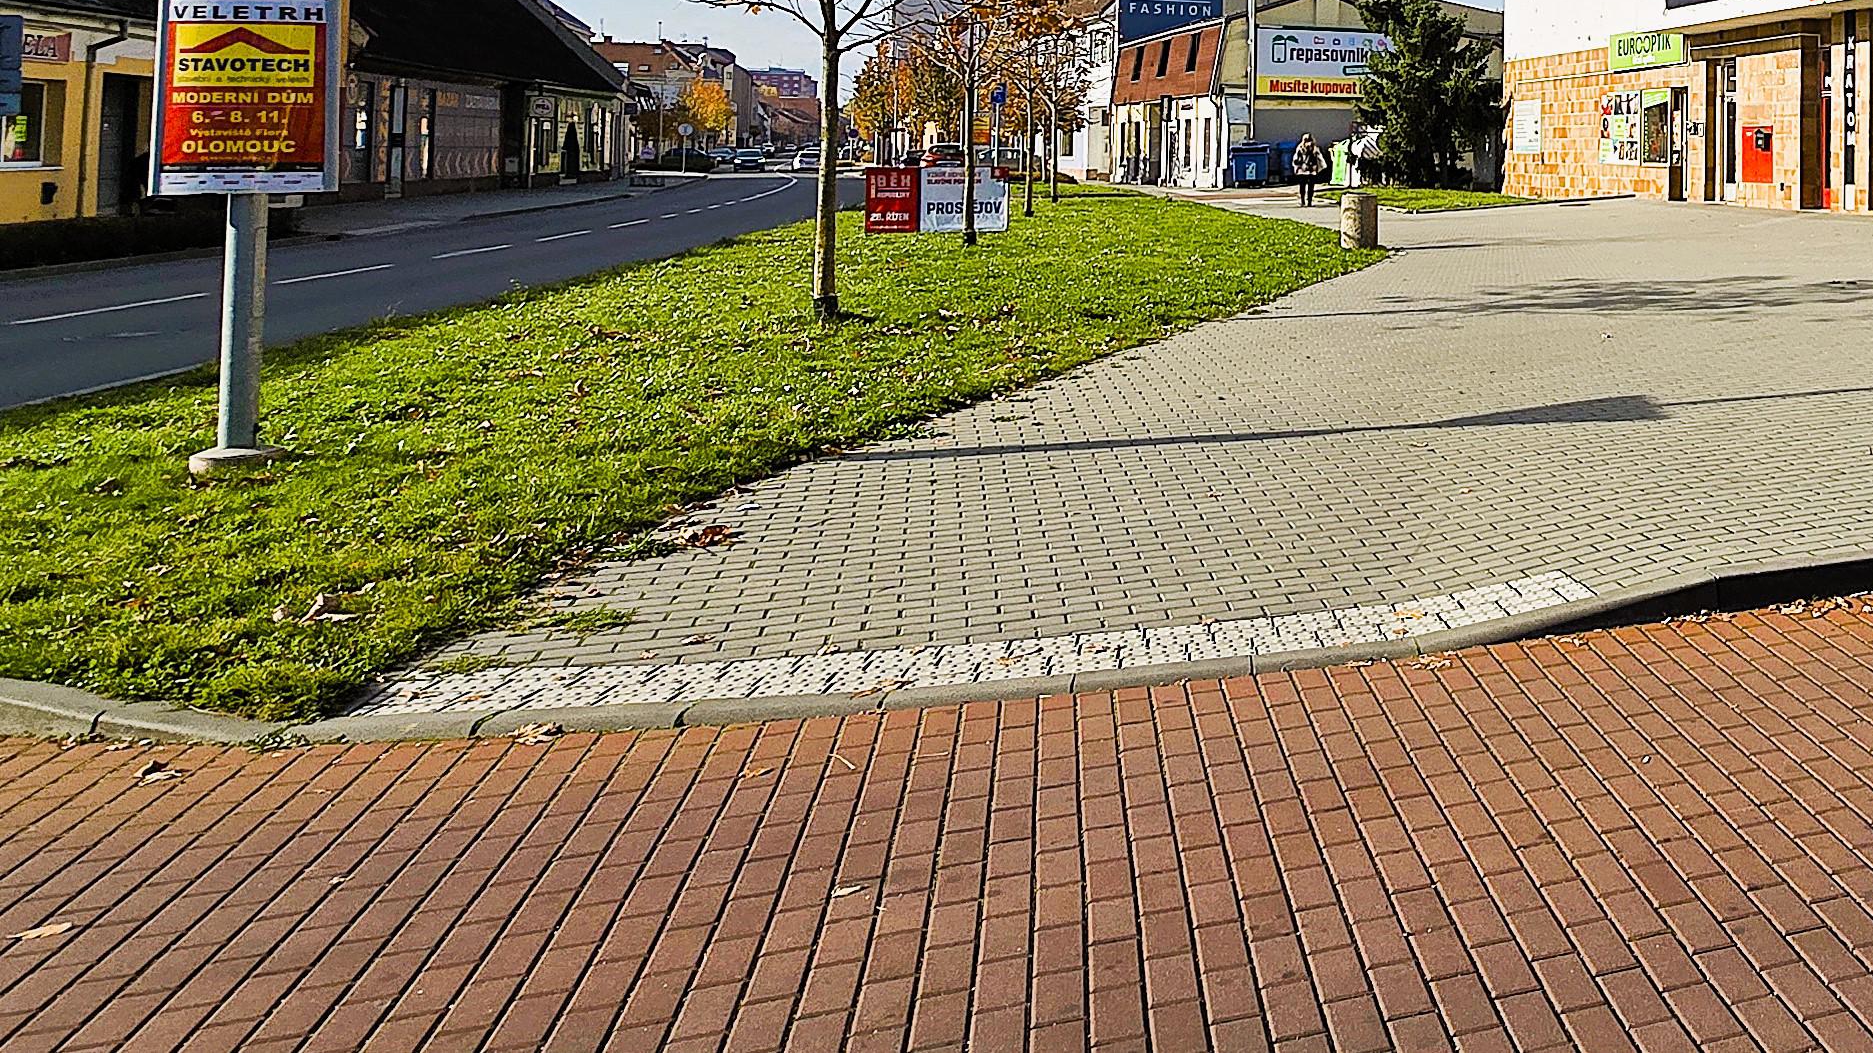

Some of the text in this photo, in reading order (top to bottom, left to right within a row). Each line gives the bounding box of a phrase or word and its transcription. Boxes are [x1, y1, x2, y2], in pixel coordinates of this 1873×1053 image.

[173, 5, 325, 22] VELETRH
[1129, 2, 1212, 17] FASHION
[1617, 33, 1672, 57] EUROOPTIK
[178, 57, 310, 72] STAVOTECH
[1310, 80, 1358, 95] kupovat
[1845, 36, 1856, 146] KRATOM
[172, 89, 314, 104] MODERNÍ DŮM
[230, 110, 250, 123] 8.
[256, 110, 286, 124] 11.
[181, 140, 296, 154] OLOMOUC
[877, 171, 911, 187] BĚH
[926, 198, 1003, 215] PROSĚJOV
